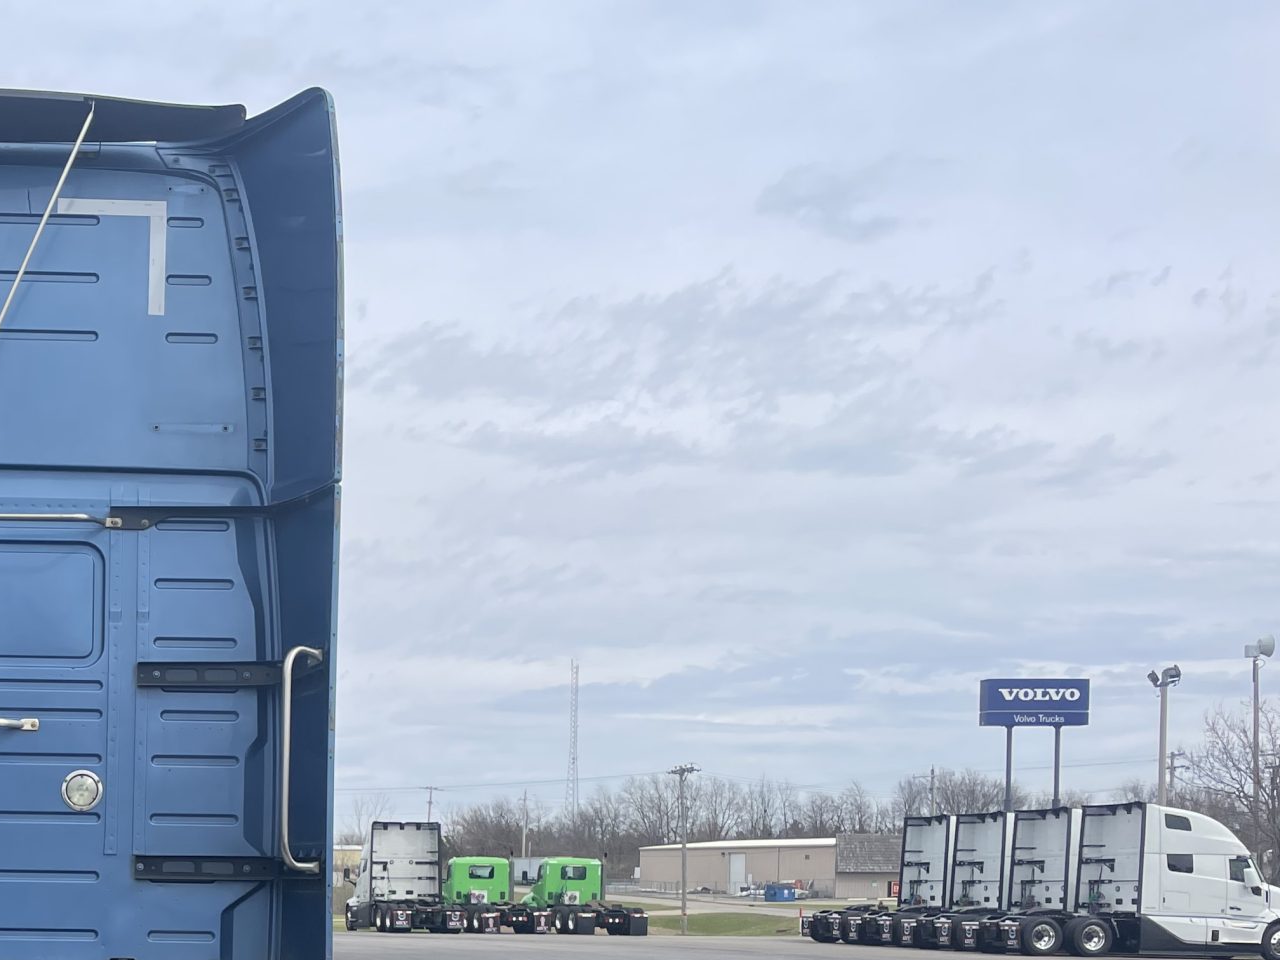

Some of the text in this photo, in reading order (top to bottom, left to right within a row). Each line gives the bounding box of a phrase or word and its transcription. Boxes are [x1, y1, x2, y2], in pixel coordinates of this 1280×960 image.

[998, 688, 1081, 701] VOLVO
[1014, 714, 1065, 723] Volvo Trucks
